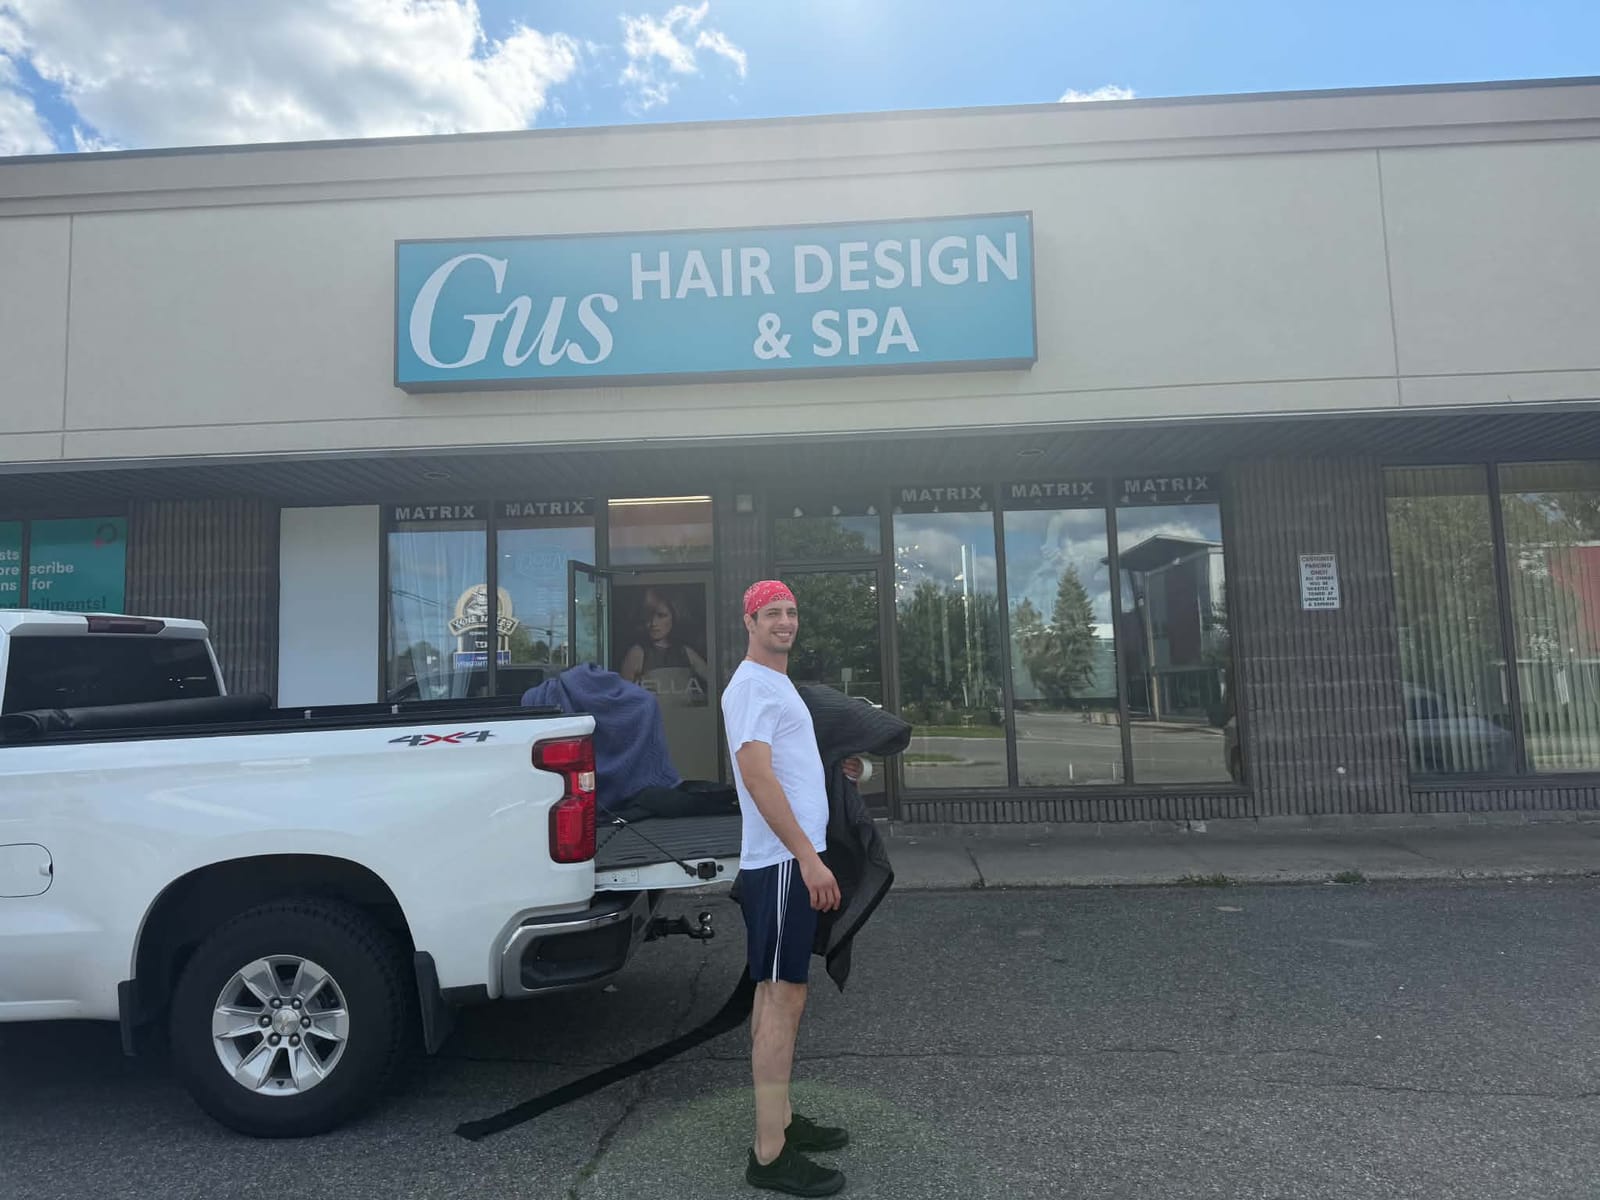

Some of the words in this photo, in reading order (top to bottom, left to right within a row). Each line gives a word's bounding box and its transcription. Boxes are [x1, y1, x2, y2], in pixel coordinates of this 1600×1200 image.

[631, 247, 776, 301] HAIR
[794, 231, 1019, 295] DESIGN
[408, 252, 619, 370] Gus
[753, 312, 792, 361] &
[812, 306, 921, 358] SPA
[901, 485, 983, 503] MATRIX
[1011, 481, 1095, 498] MATRIX
[1124, 476, 1209, 494] MATRIX
[395, 504, 476, 521] MATRIX
[505, 500, 586, 517] MATRIX
[30, 562, 74, 574] scribe
[31, 578, 53, 590] for
[635, 678, 704, 696] ELLA
